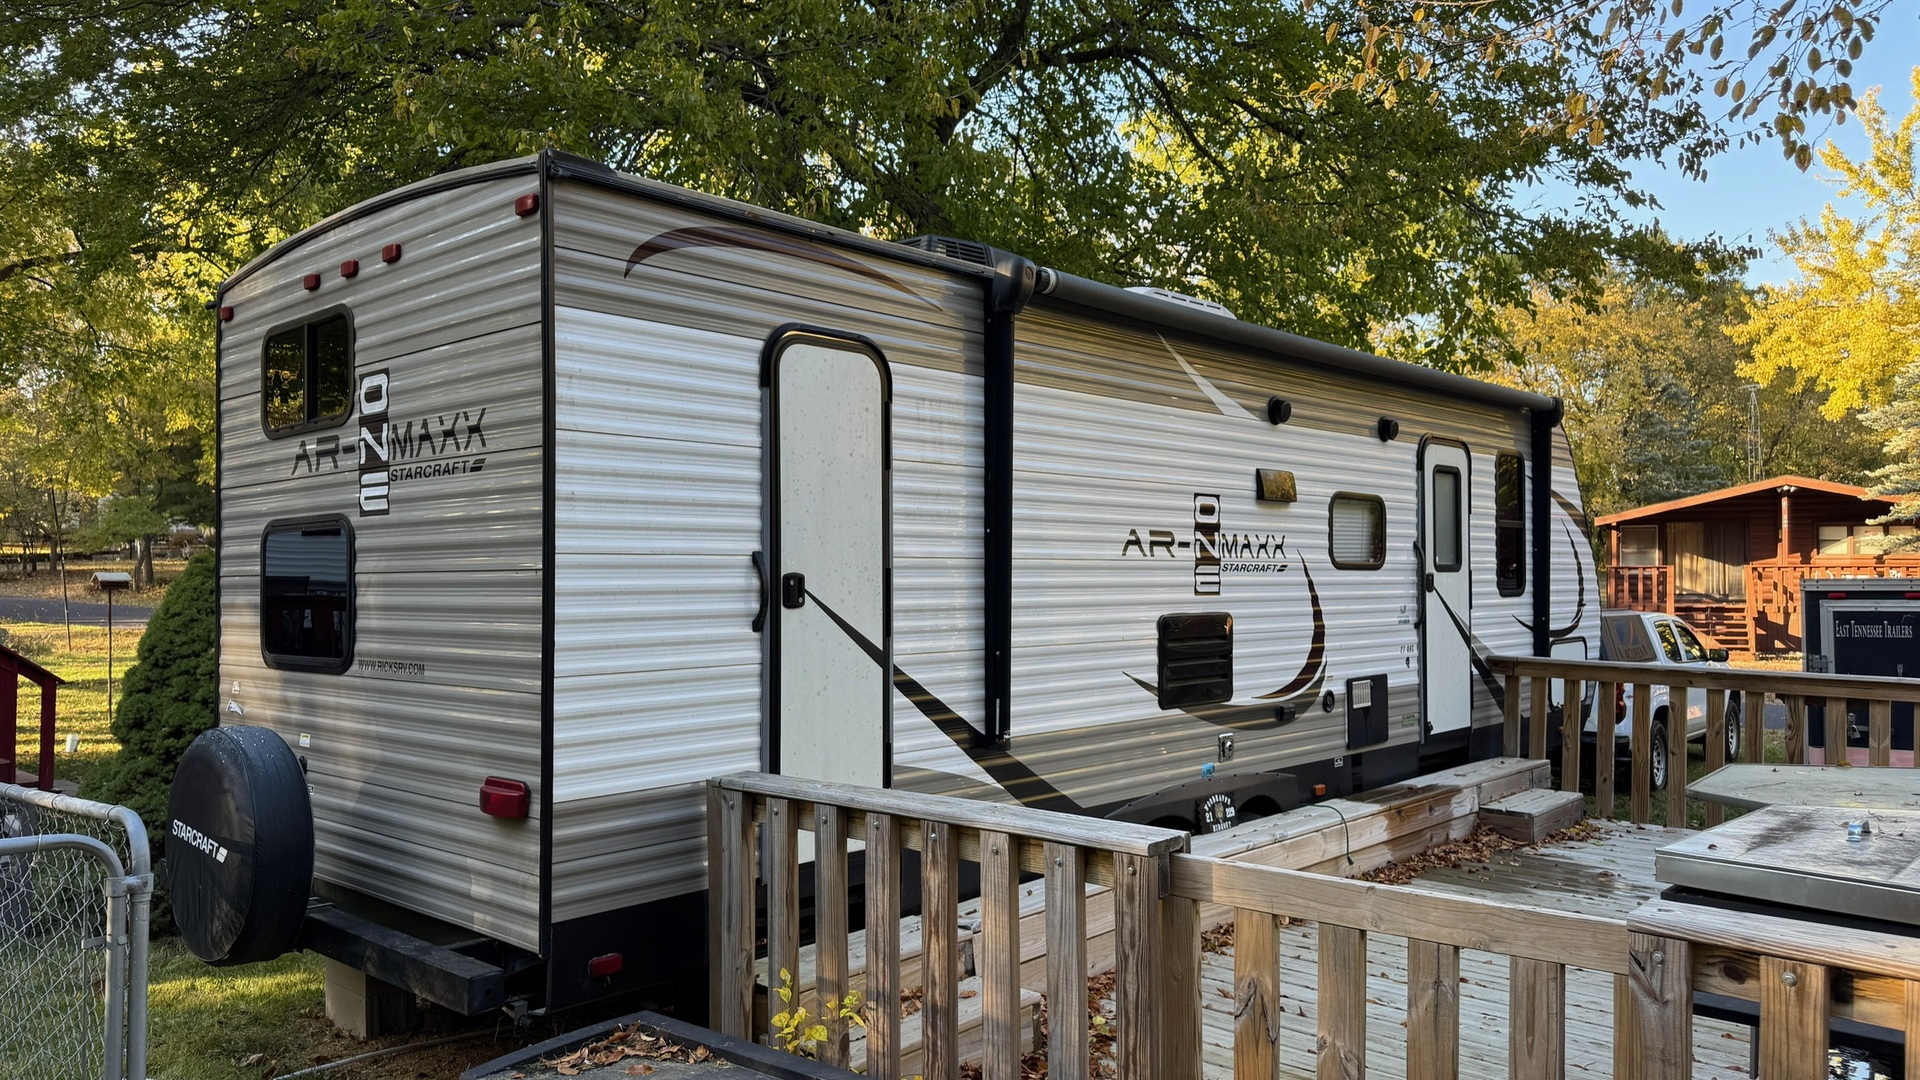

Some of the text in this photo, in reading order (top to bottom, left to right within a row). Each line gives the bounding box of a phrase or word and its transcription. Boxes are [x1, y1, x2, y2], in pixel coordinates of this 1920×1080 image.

[391, 408, 487, 460] MAXX
[390, 460, 470, 482] STARCRAFT
[1221, 533, 1287, 559] MAXX
[1221, 563, 1278, 573] STARCRAFT
[1835, 620, 1913, 639] EAST TENNESSEE TRAILERS
[357, 659, 425, 676] WWW.RICKSRV.COM
[1205, 811, 1214, 823] 21
[171, 818, 219, 859] STARCRAFT
